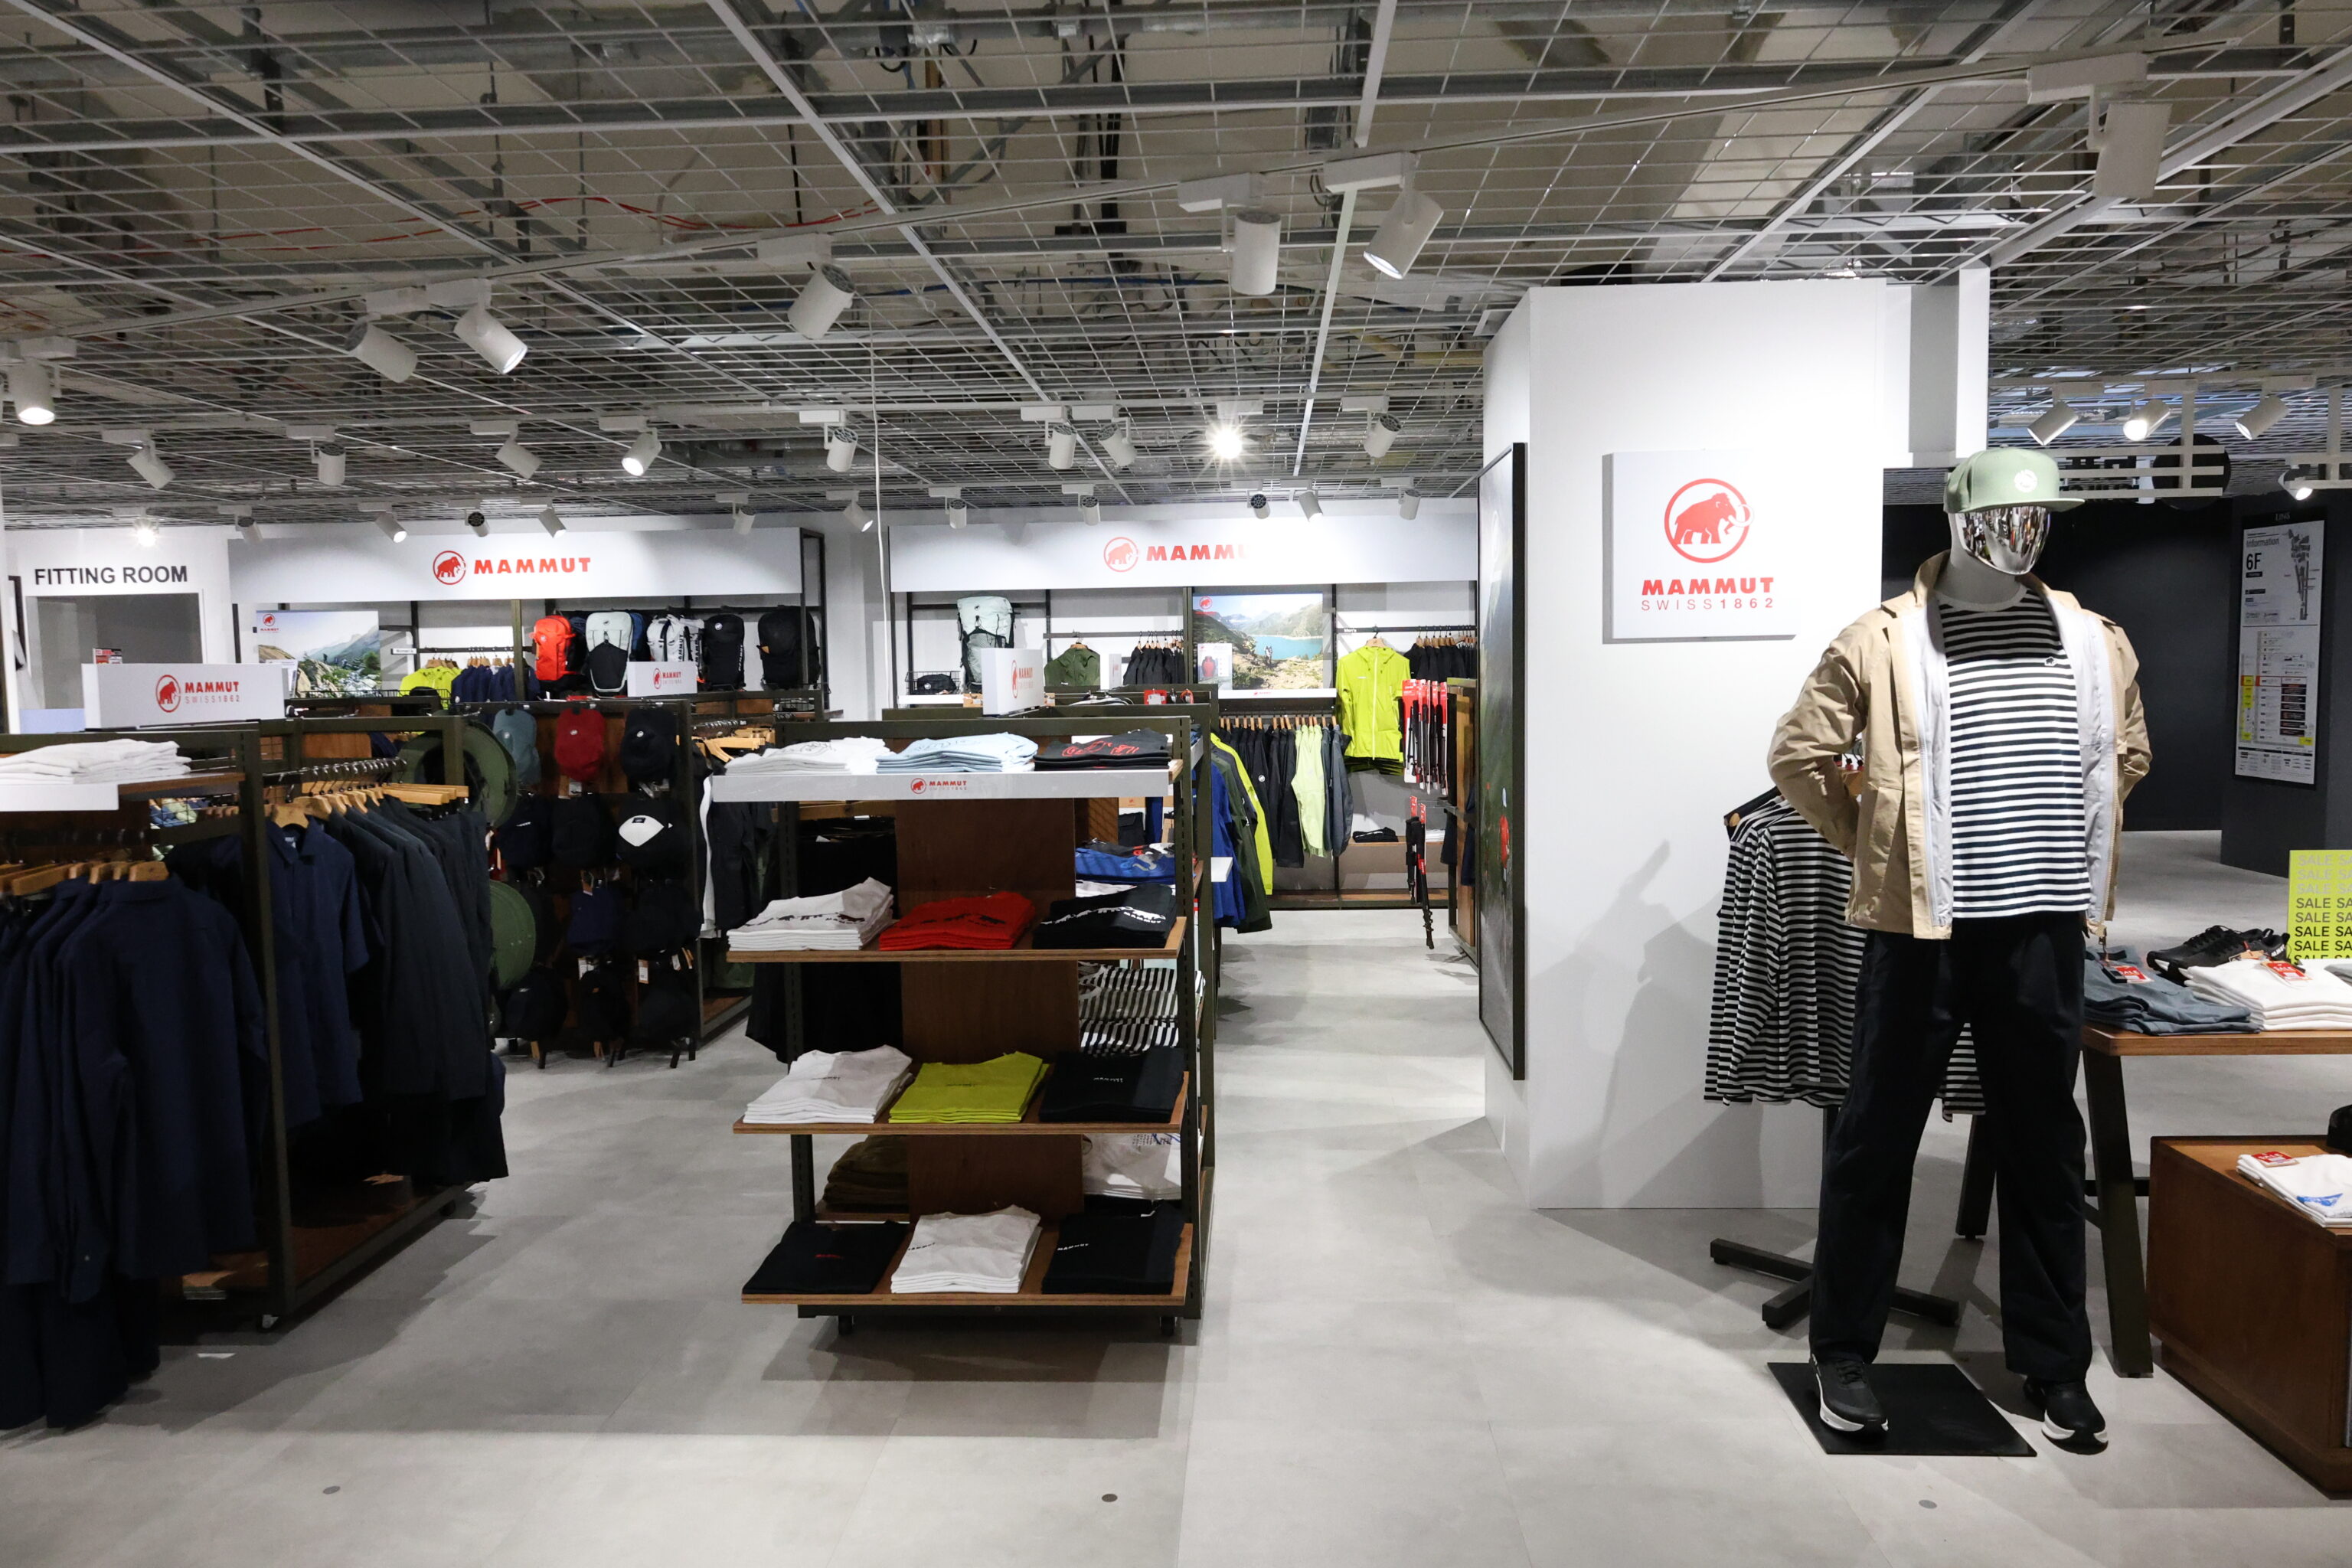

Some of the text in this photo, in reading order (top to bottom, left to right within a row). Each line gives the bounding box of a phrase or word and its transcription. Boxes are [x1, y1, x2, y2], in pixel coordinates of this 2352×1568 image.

[2246, 538, 2279, 547] Information
[474, 557, 591, 574] MAMMUT
[2246, 552, 2262, 570] 6F
[34, 565, 188, 585] FITTING ROOM
[1642, 577, 1774, 596] MAMMUT
[185, 681, 239, 694] MAMMUT
[2298, 854, 2332, 866] SALE
[2298, 869, 2331, 880] SALE
[2297, 883, 2331, 894] SALE
[2295, 898, 2331, 909] SALE
[1123, 911, 1161, 923] MAMMUT
[2295, 912, 2331, 923] SALE
[2295, 926, 2330, 937] SALE
[2294, 940, 2329, 951] SALE
